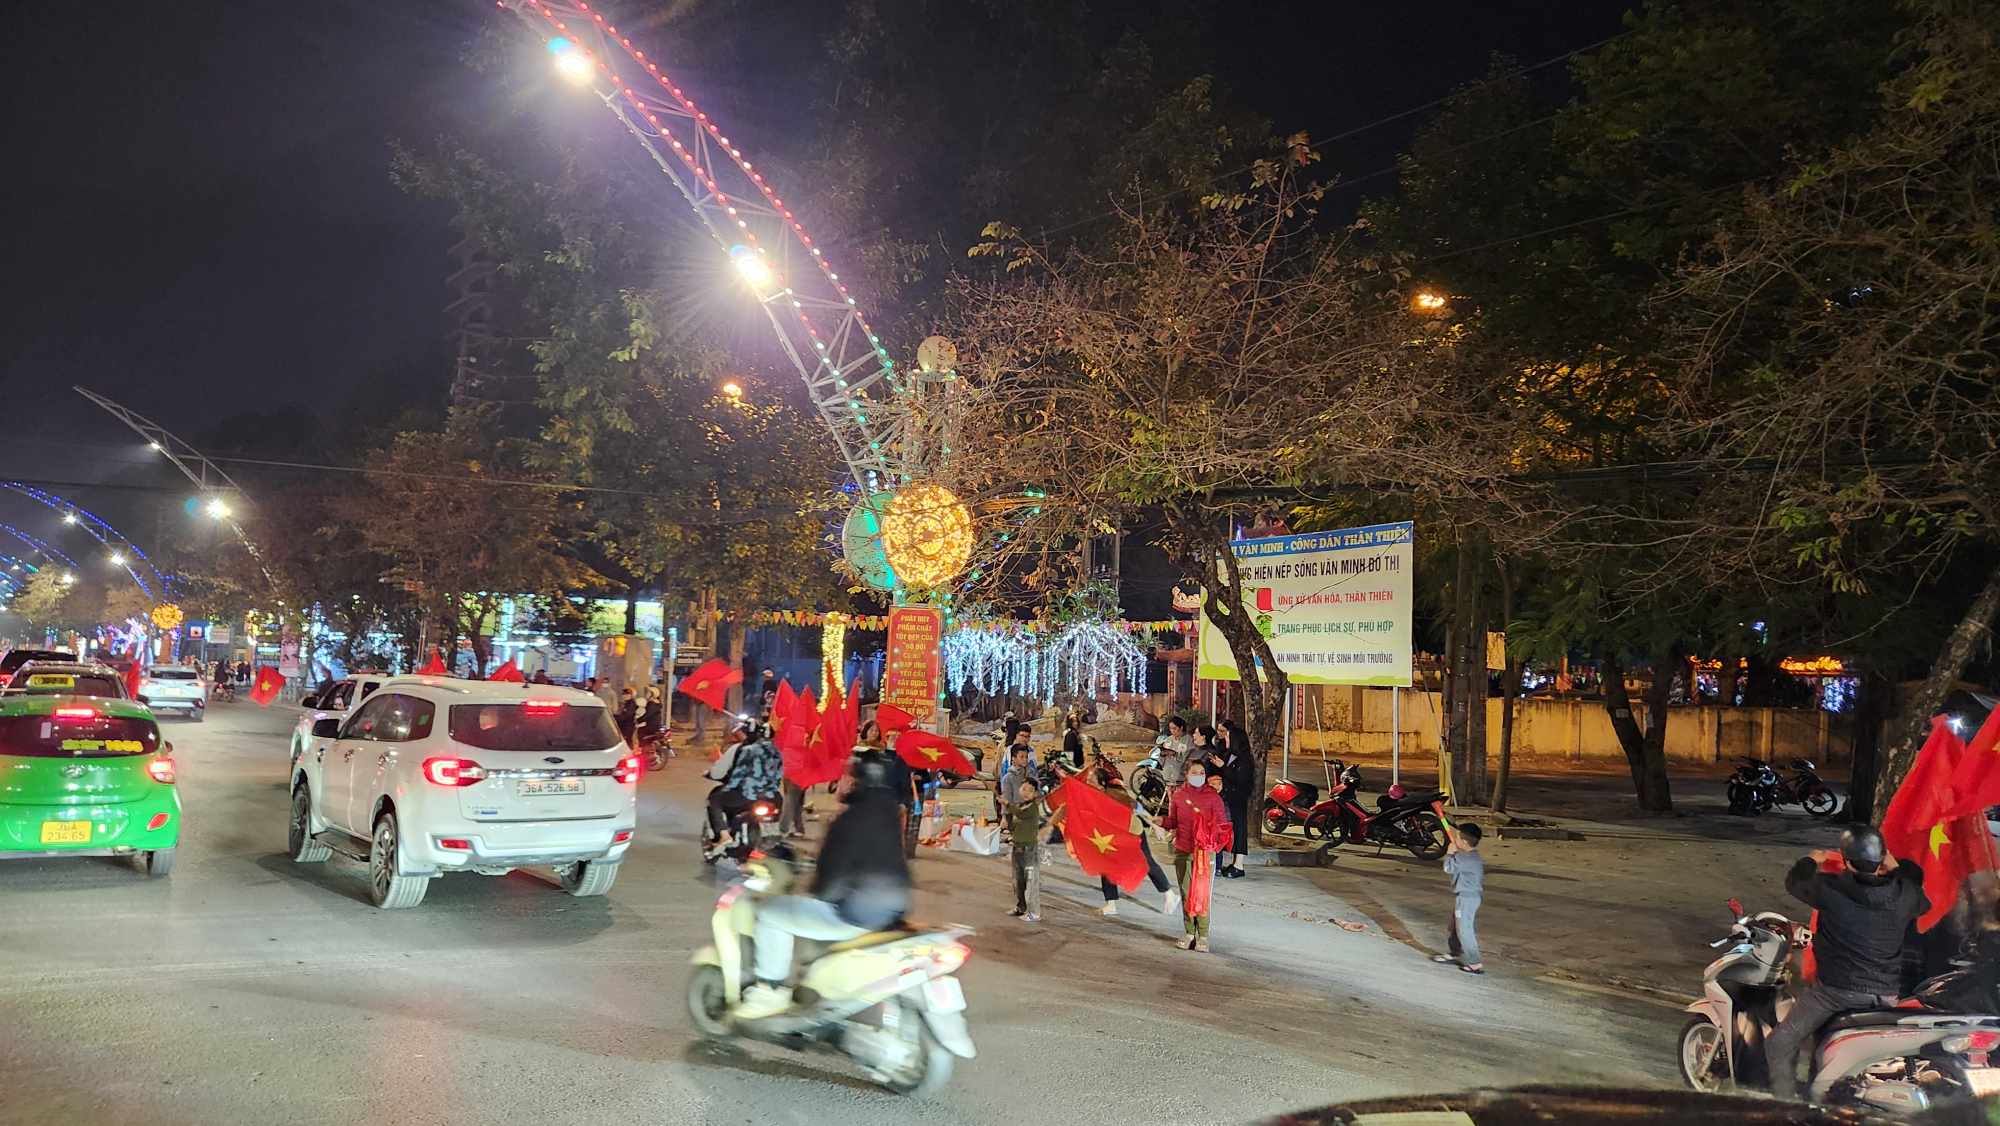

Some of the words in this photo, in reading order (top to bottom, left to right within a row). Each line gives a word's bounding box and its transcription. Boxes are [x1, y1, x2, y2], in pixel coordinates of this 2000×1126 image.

[1260, 542, 1284, 553] MINH
[1291, 537, 1317, 551] CÔNG
[1319, 534, 1341, 548] DÂN
[1254, 563, 1273, 583] HIỆN
[1276, 560, 1291, 579] NẾP
[1295, 558, 1317, 578] SỐNG
[1320, 558, 1338, 576] VĂN
[1341, 557, 1365, 574] MINH
[1385, 555, 1400, 574] THỊ
[1278, 623, 1301, 634] TRANG
[1325, 623, 1341, 635] LỊCH
[1337, 653, 1351, 664] SINH
